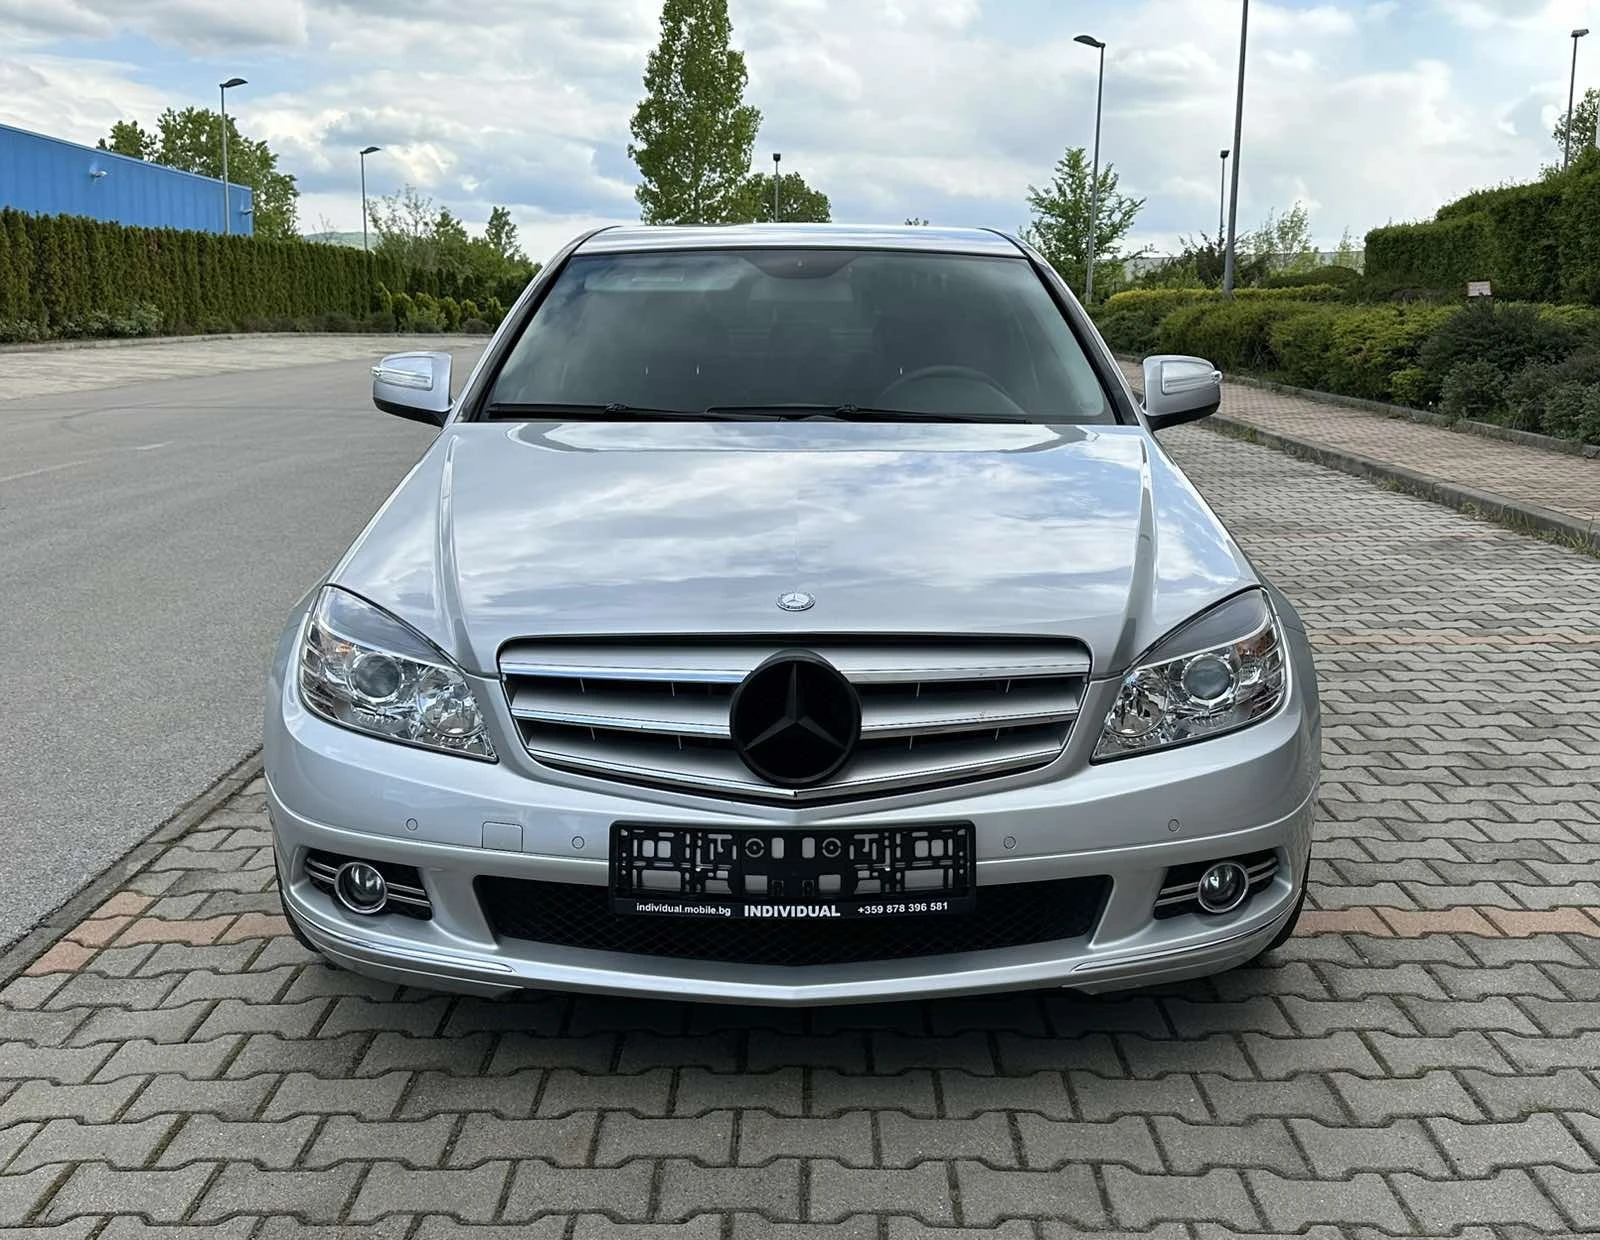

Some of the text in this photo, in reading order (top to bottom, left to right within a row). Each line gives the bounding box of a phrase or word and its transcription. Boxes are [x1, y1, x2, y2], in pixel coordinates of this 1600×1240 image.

[636, 902, 948, 917] individual.mobile.bg INDIVIDUAL +359 878 396 581
